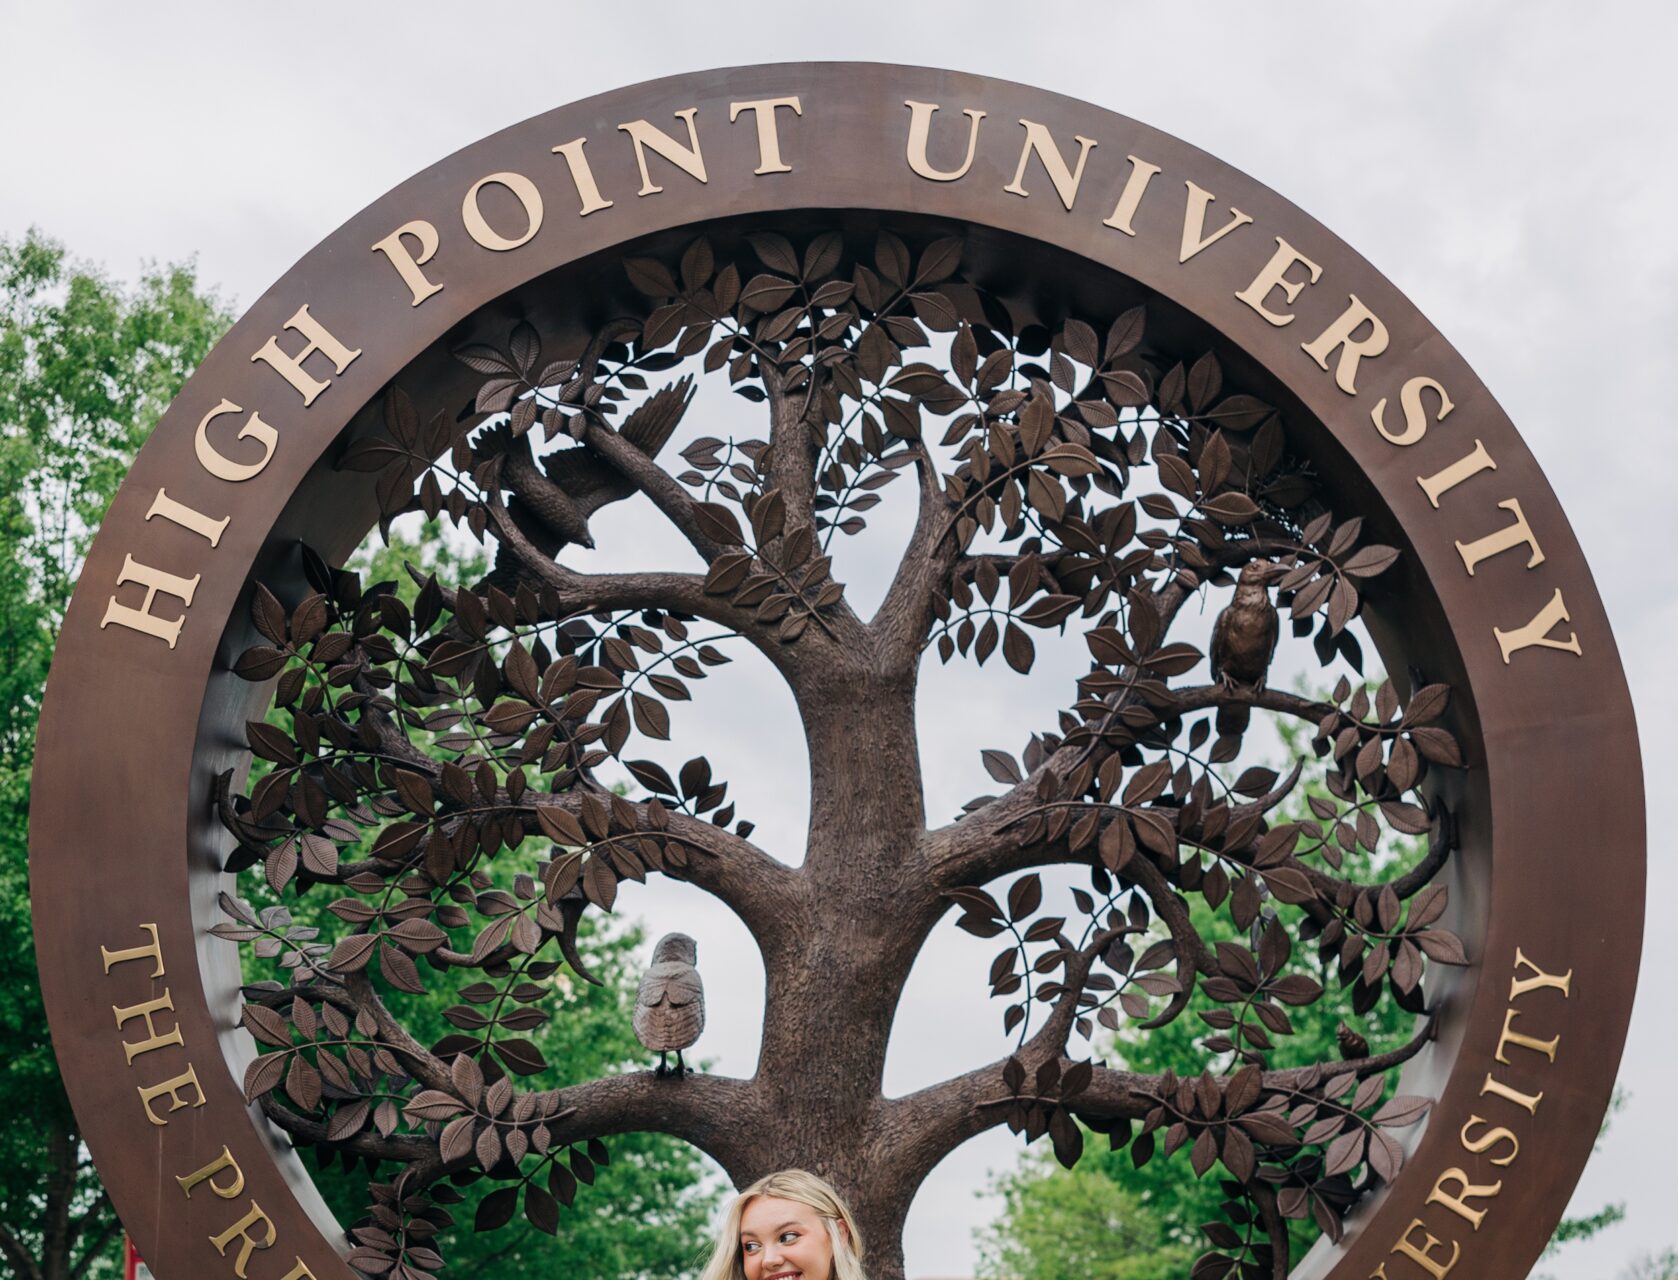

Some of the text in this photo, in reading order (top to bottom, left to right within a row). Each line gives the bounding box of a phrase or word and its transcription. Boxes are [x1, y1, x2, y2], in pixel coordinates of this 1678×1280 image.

[100, 96, 1583, 664] HIGH POINT UNIVERSITY
[100, 922, 207, 1127] THE
